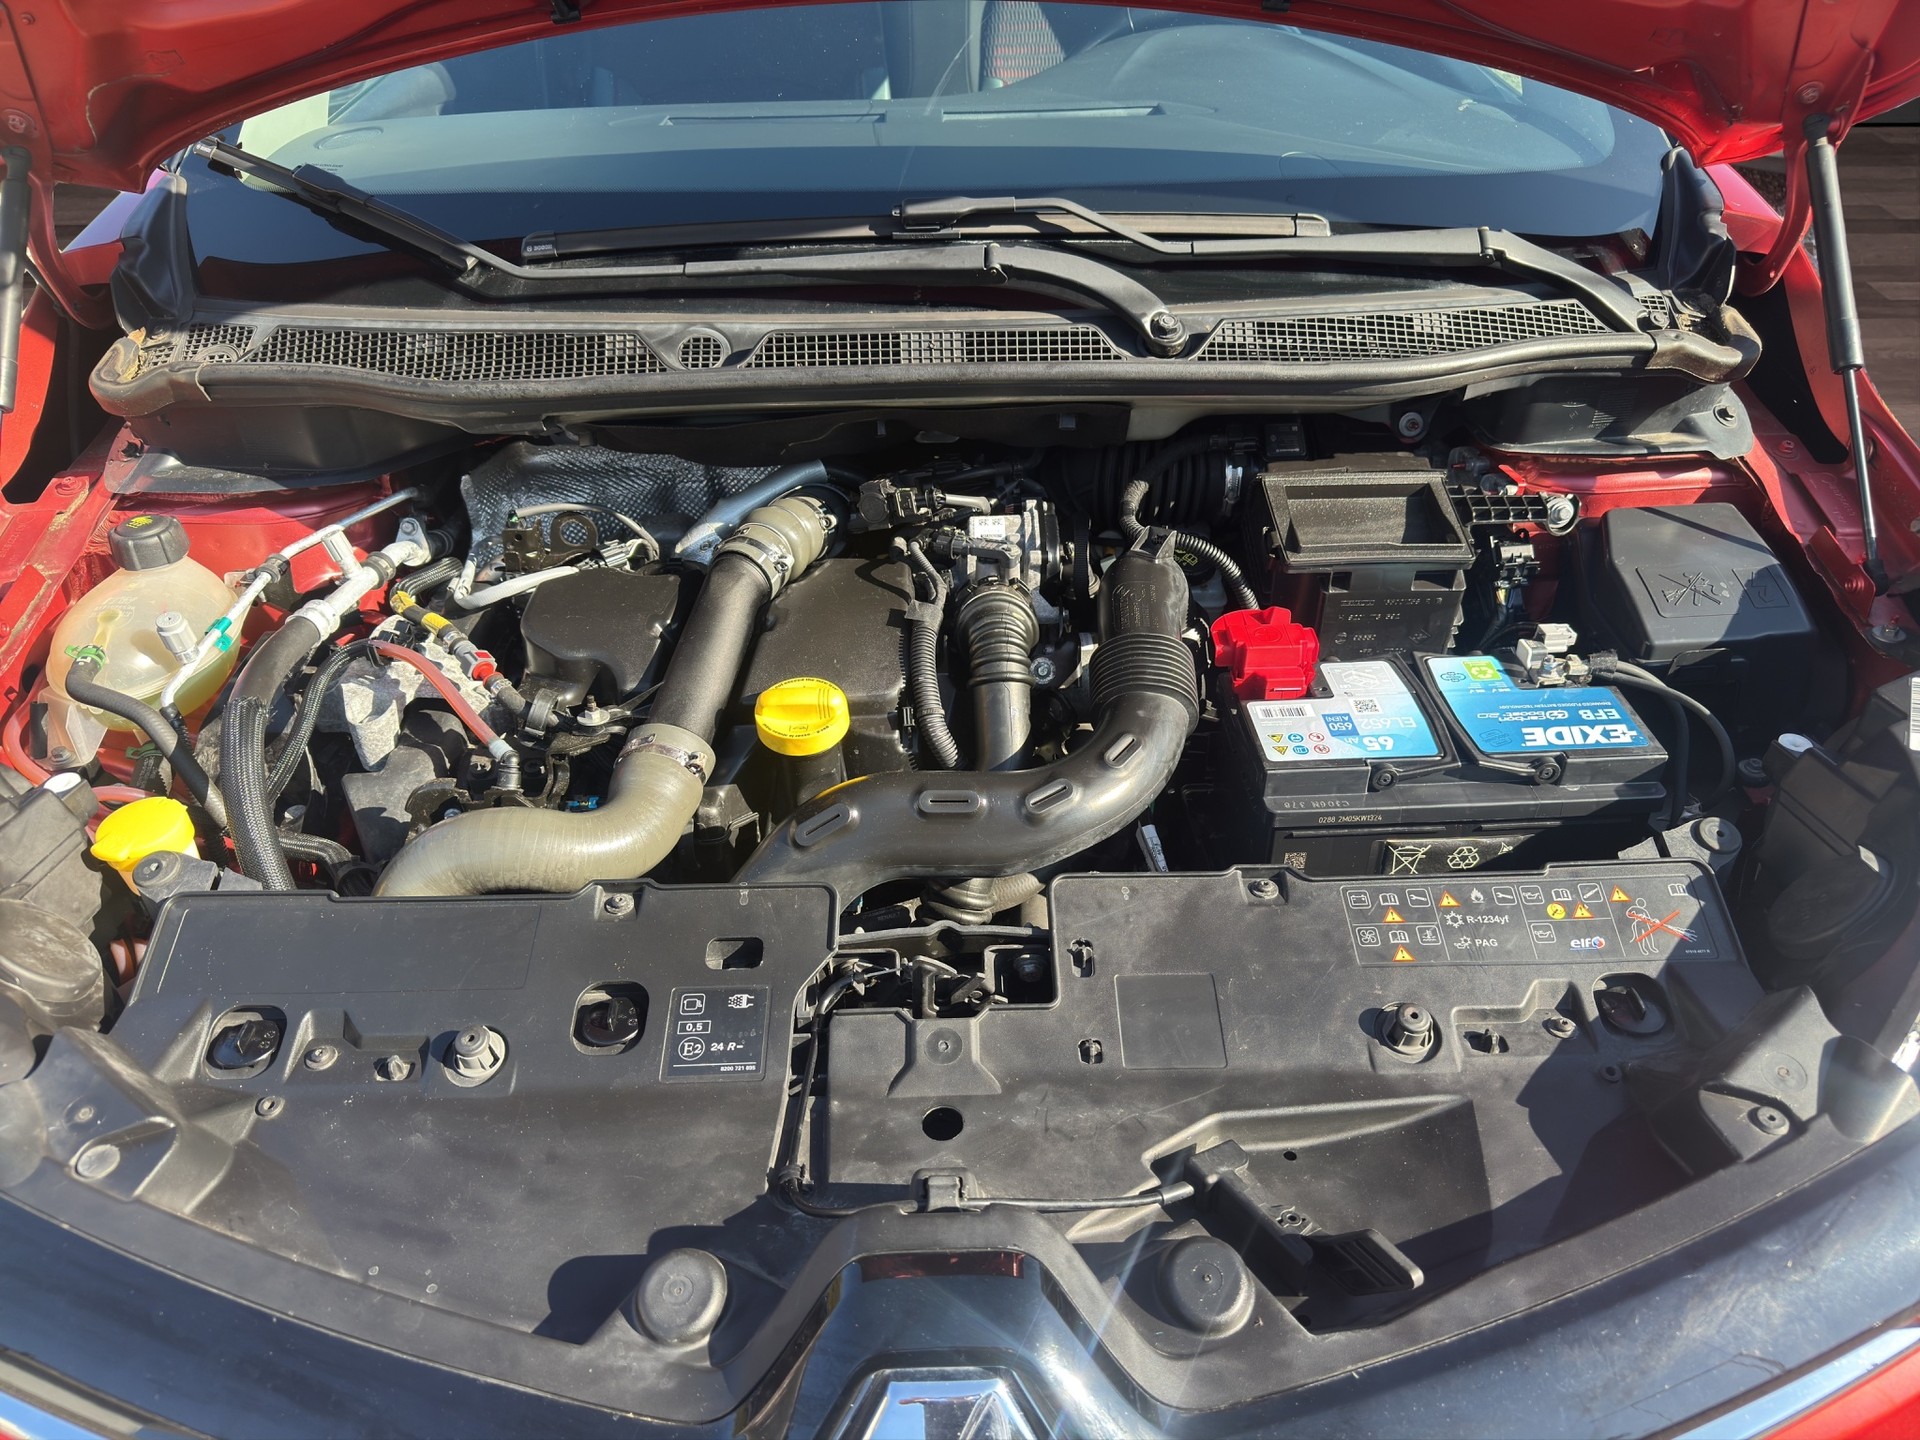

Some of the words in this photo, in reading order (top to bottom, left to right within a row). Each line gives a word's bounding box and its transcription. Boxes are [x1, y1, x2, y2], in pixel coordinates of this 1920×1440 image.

[1578, 708, 1621, 720] EFB
[1328, 722, 1353, 731] 650
[1357, 716, 1417, 729] EL652
[1521, 724, 1637, 746] EXIDE
[1363, 735, 1394, 751] 65
[1465, 914, 1510, 925] R-1234yf
[1474, 938, 1499, 947] PAG
[1570, 938, 1592, 948] elf
[686, 1023, 703, 1032] 0,5
[682, 1043, 702, 1056] E2
[710, 1042, 724, 1051] 24
